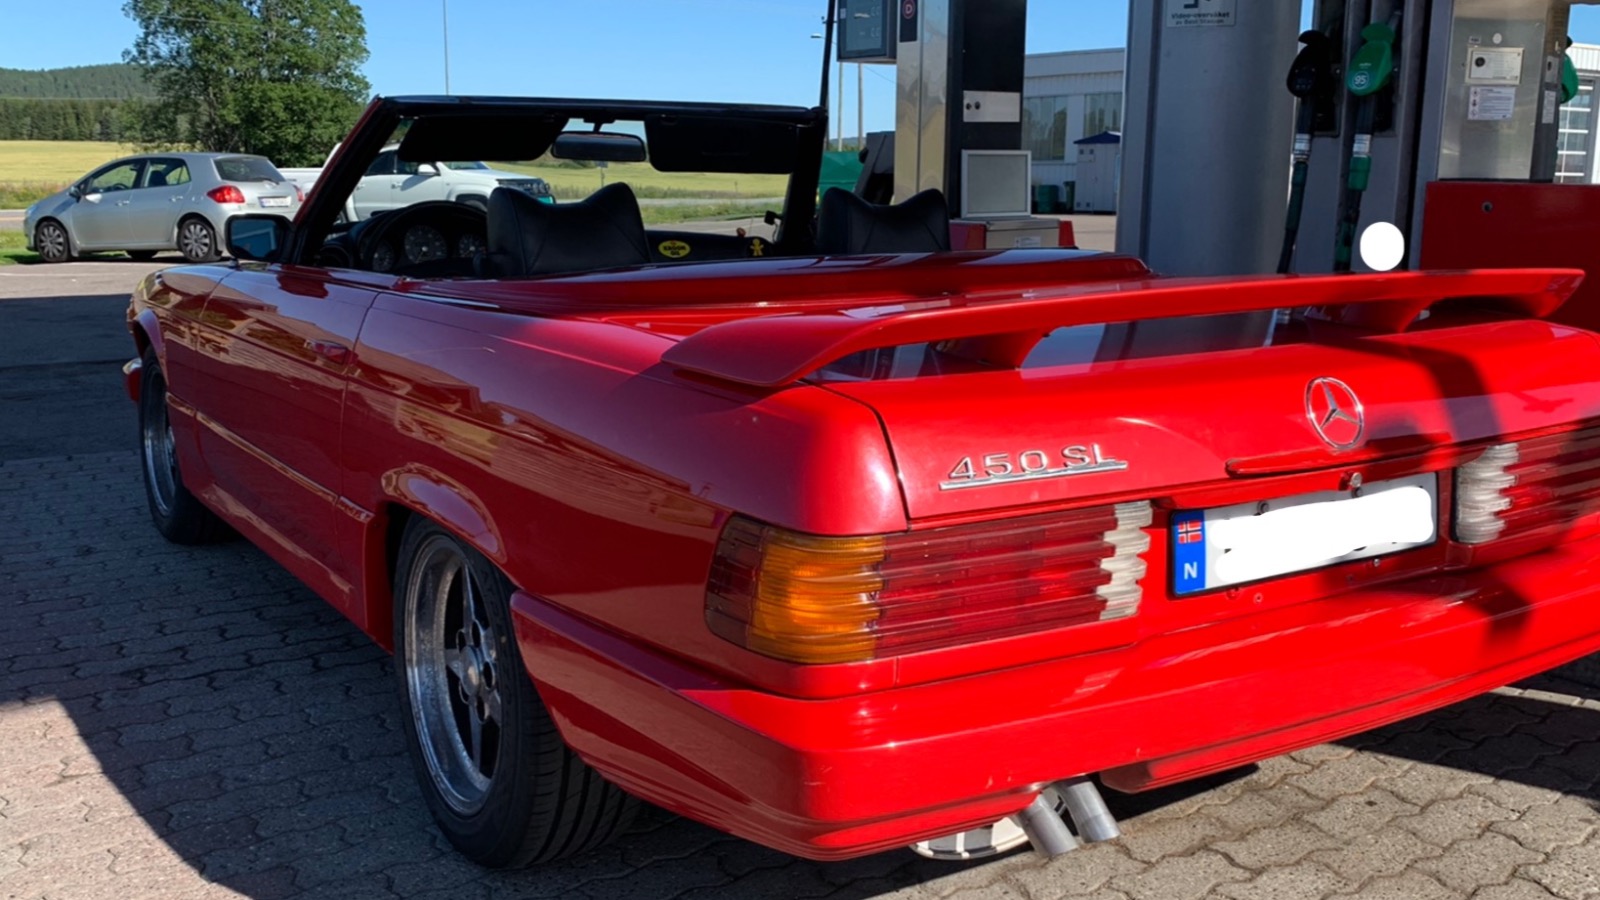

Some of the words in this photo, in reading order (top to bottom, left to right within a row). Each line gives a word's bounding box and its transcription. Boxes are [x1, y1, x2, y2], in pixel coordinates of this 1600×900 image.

[905, 4, 913, 14] D
[1354, 75, 1367, 84] 95
[948, 450, 1049, 480] 450
[1062, 443, 1116, 468] SL
[1184, 562, 1198, 580] N
